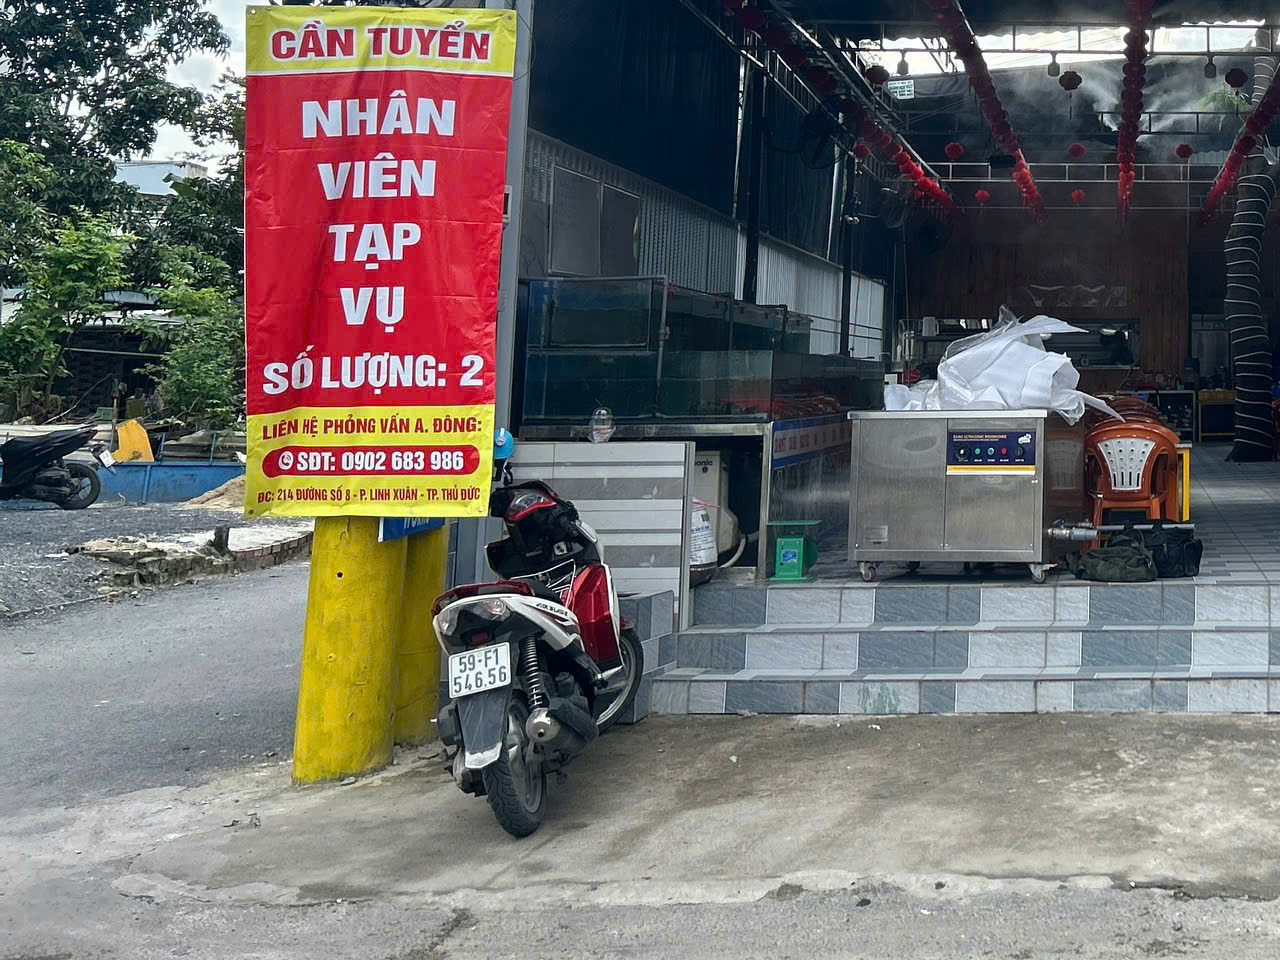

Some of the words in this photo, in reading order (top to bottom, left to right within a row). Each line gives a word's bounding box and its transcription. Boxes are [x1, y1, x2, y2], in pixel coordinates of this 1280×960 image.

[271, 20, 354, 59] CẦN
[367, 20, 490, 60] TUYỂN
[302, 89, 456, 139] NHÂN
[317, 153, 436, 200] VIÊN
[328, 223, 421, 270] TẠP
[339, 286, 405, 333] VỤ
[262, 344, 314, 395] SỐ
[321, 352, 447, 395] LƯỢNG:
[459, 355, 484, 387] 2
[262, 419, 298, 440] LIÊN
[302, 416, 318, 437] HỆ
[323, 414, 376, 434] PHỎNG
[380, 413, 410, 433] VẤN
[414, 418, 429, 433] A.
[296, 451, 336, 471] SĐT:
[342, 451, 386, 471] 0902
[391, 451, 425, 470] 683
[430, 451, 464, 470] 986
[257, 492, 274, 503] ĐC:
[277, 489, 293, 501] 214
[296, 486, 327, 501] ĐƯỜNG
[330, 485, 343, 500] SỐ
[345, 490, 351, 501] 8
[360, 489, 368, 501] P.
[370, 489, 391, 501] LINH
[393, 486, 418, 500] XUÂN
[427, 489, 440, 501] TP.
[442, 486, 458, 500] THỦ
[460, 486, 480, 501] ĐỨC
[454, 665, 507, 694] 546.56
[459, 648, 499, 674] 59-F1
